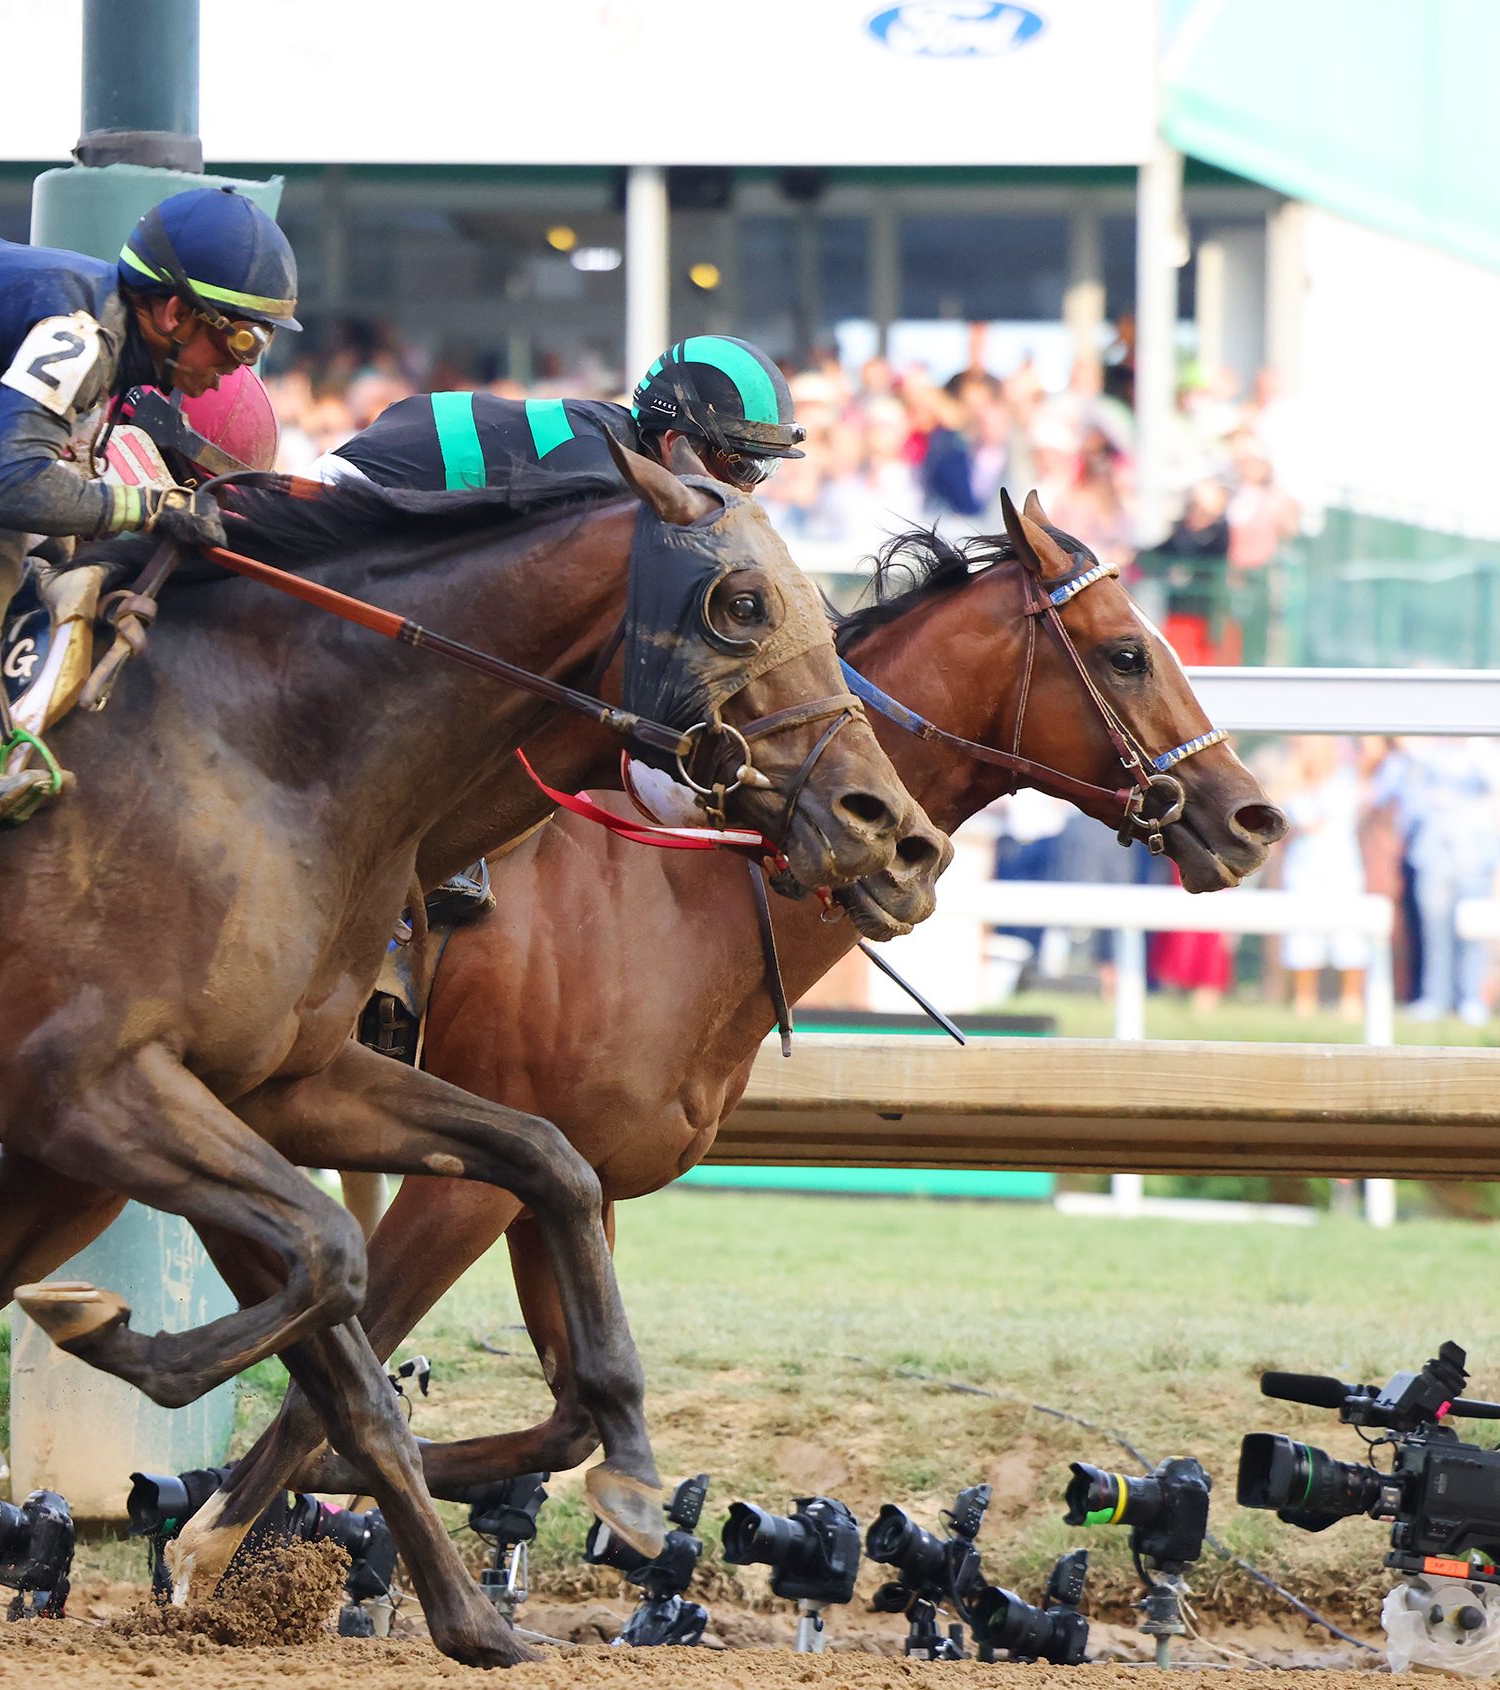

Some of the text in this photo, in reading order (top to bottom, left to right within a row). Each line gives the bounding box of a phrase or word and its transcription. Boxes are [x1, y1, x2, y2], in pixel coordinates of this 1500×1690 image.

[886, 0, 1018, 56] Ford
[27, 330, 86, 391] 2
[4, 638, 40, 678] G
